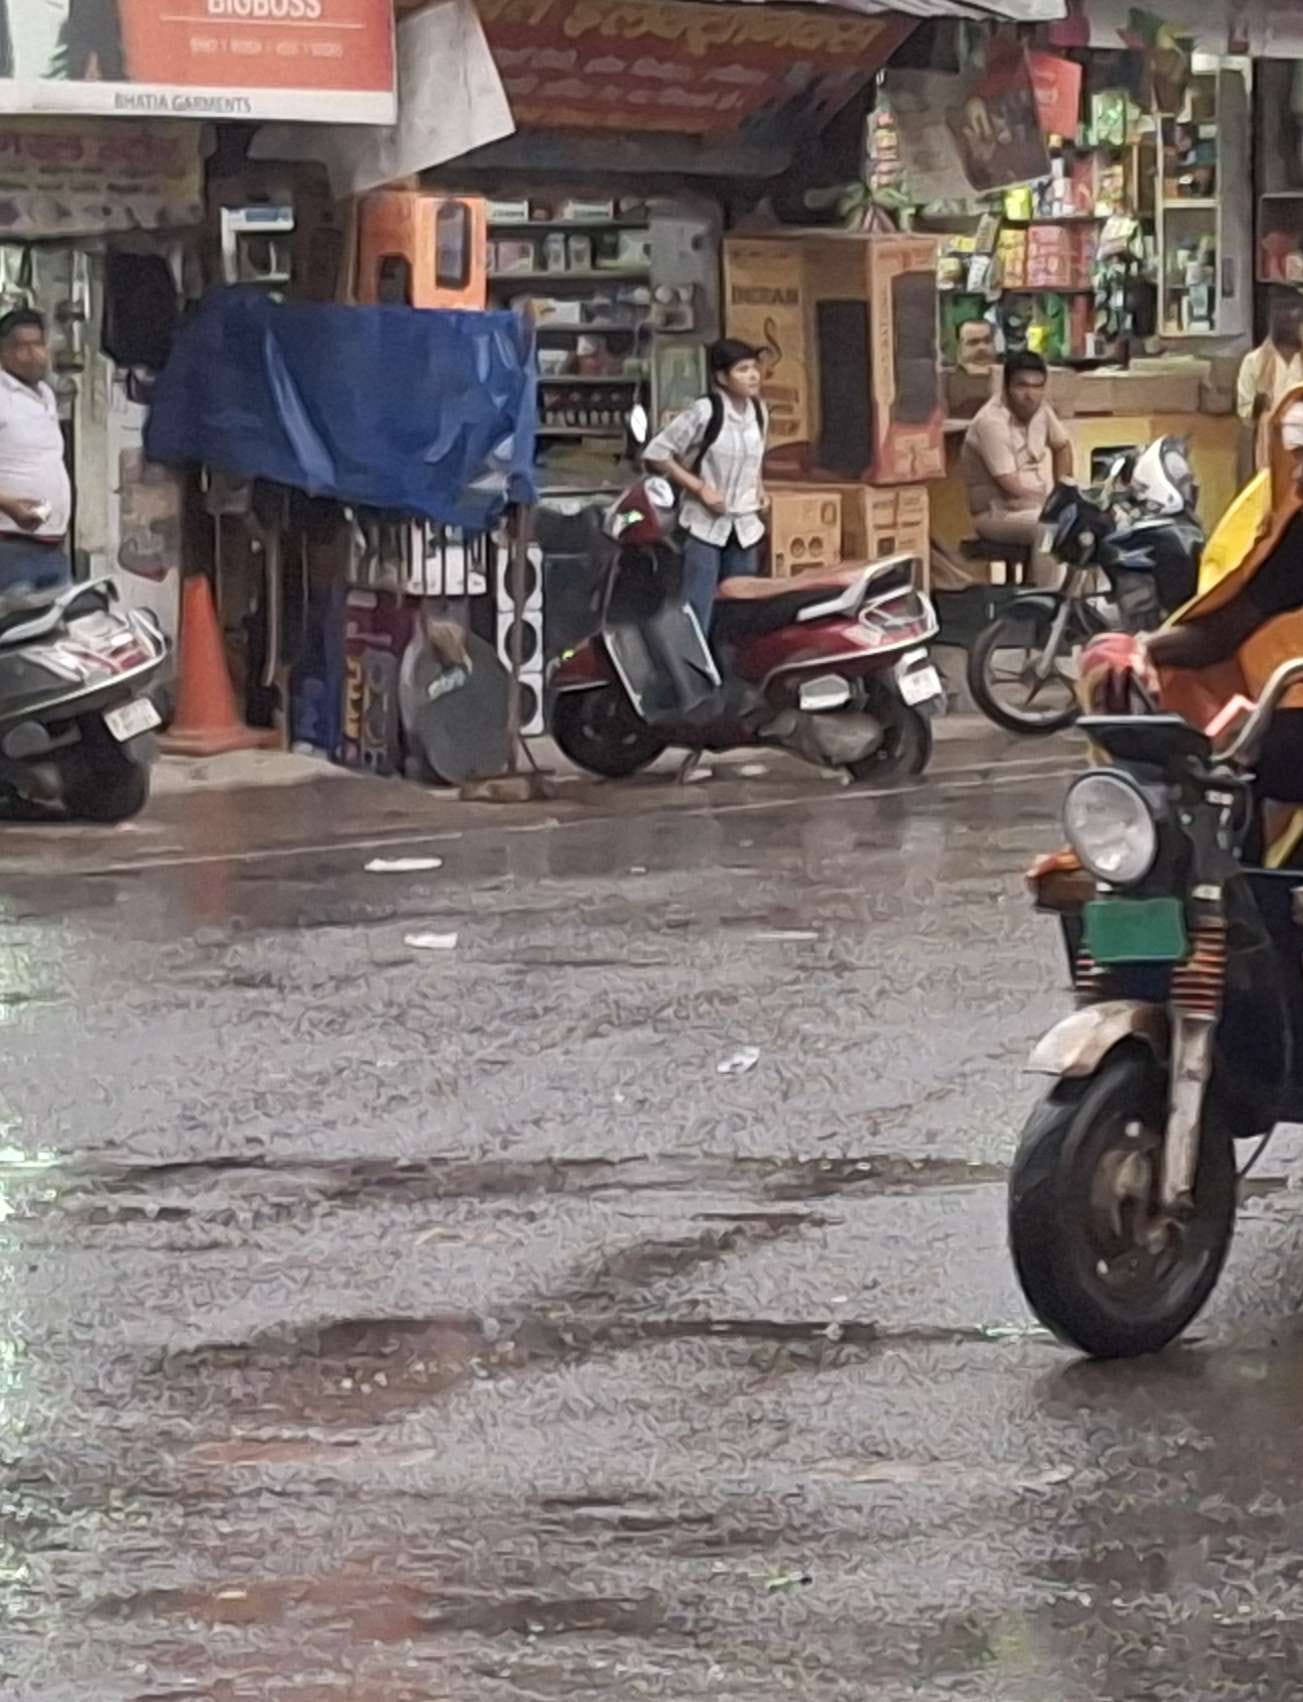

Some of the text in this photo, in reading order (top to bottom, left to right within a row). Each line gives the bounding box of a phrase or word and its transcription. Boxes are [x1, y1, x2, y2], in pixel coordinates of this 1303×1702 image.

[207, 0, 321, 18] BIGBOSS
[114, 92, 252, 113] BHATIA GARMENTS
